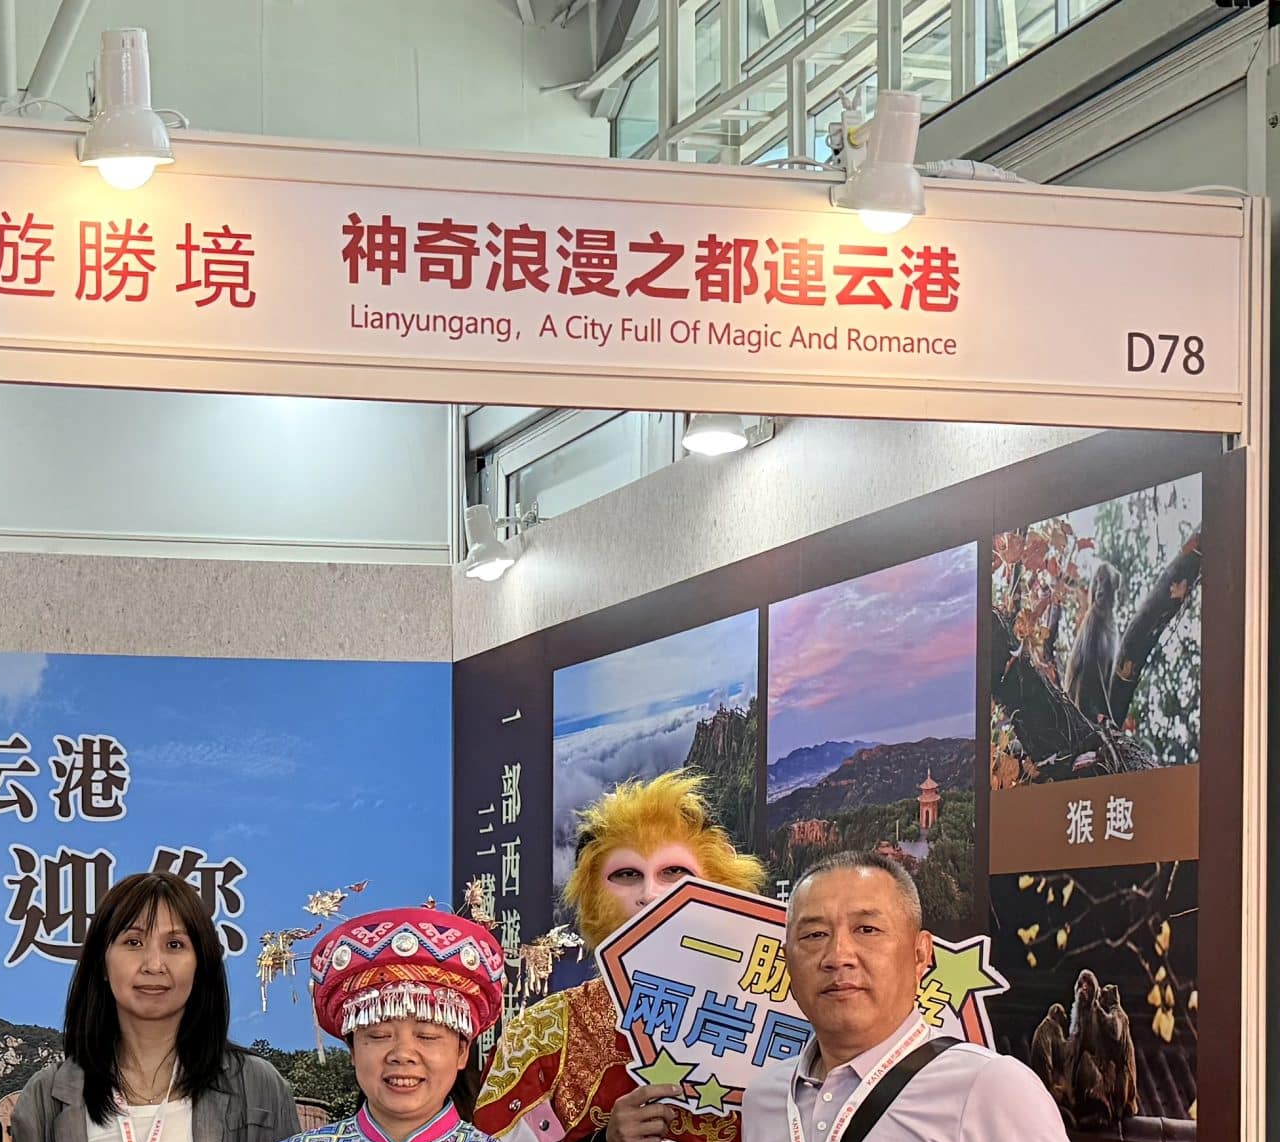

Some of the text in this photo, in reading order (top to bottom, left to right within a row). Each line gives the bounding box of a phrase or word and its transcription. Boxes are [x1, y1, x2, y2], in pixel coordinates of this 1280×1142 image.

[341, 211, 961, 313] 神奇浪漫之都連云港
[539, 315, 558, 338] A
[566, 315, 613, 347] City
[622, 318, 661, 343] Full
[671, 320, 701, 345] Of
[709, 322, 782, 353] Magic
[790, 326, 838, 350] And
[848, 328, 957, 355] Romance
[1128, 333, 1205, 376] D78
[1065, 795, 1135, 845] 猴趣
